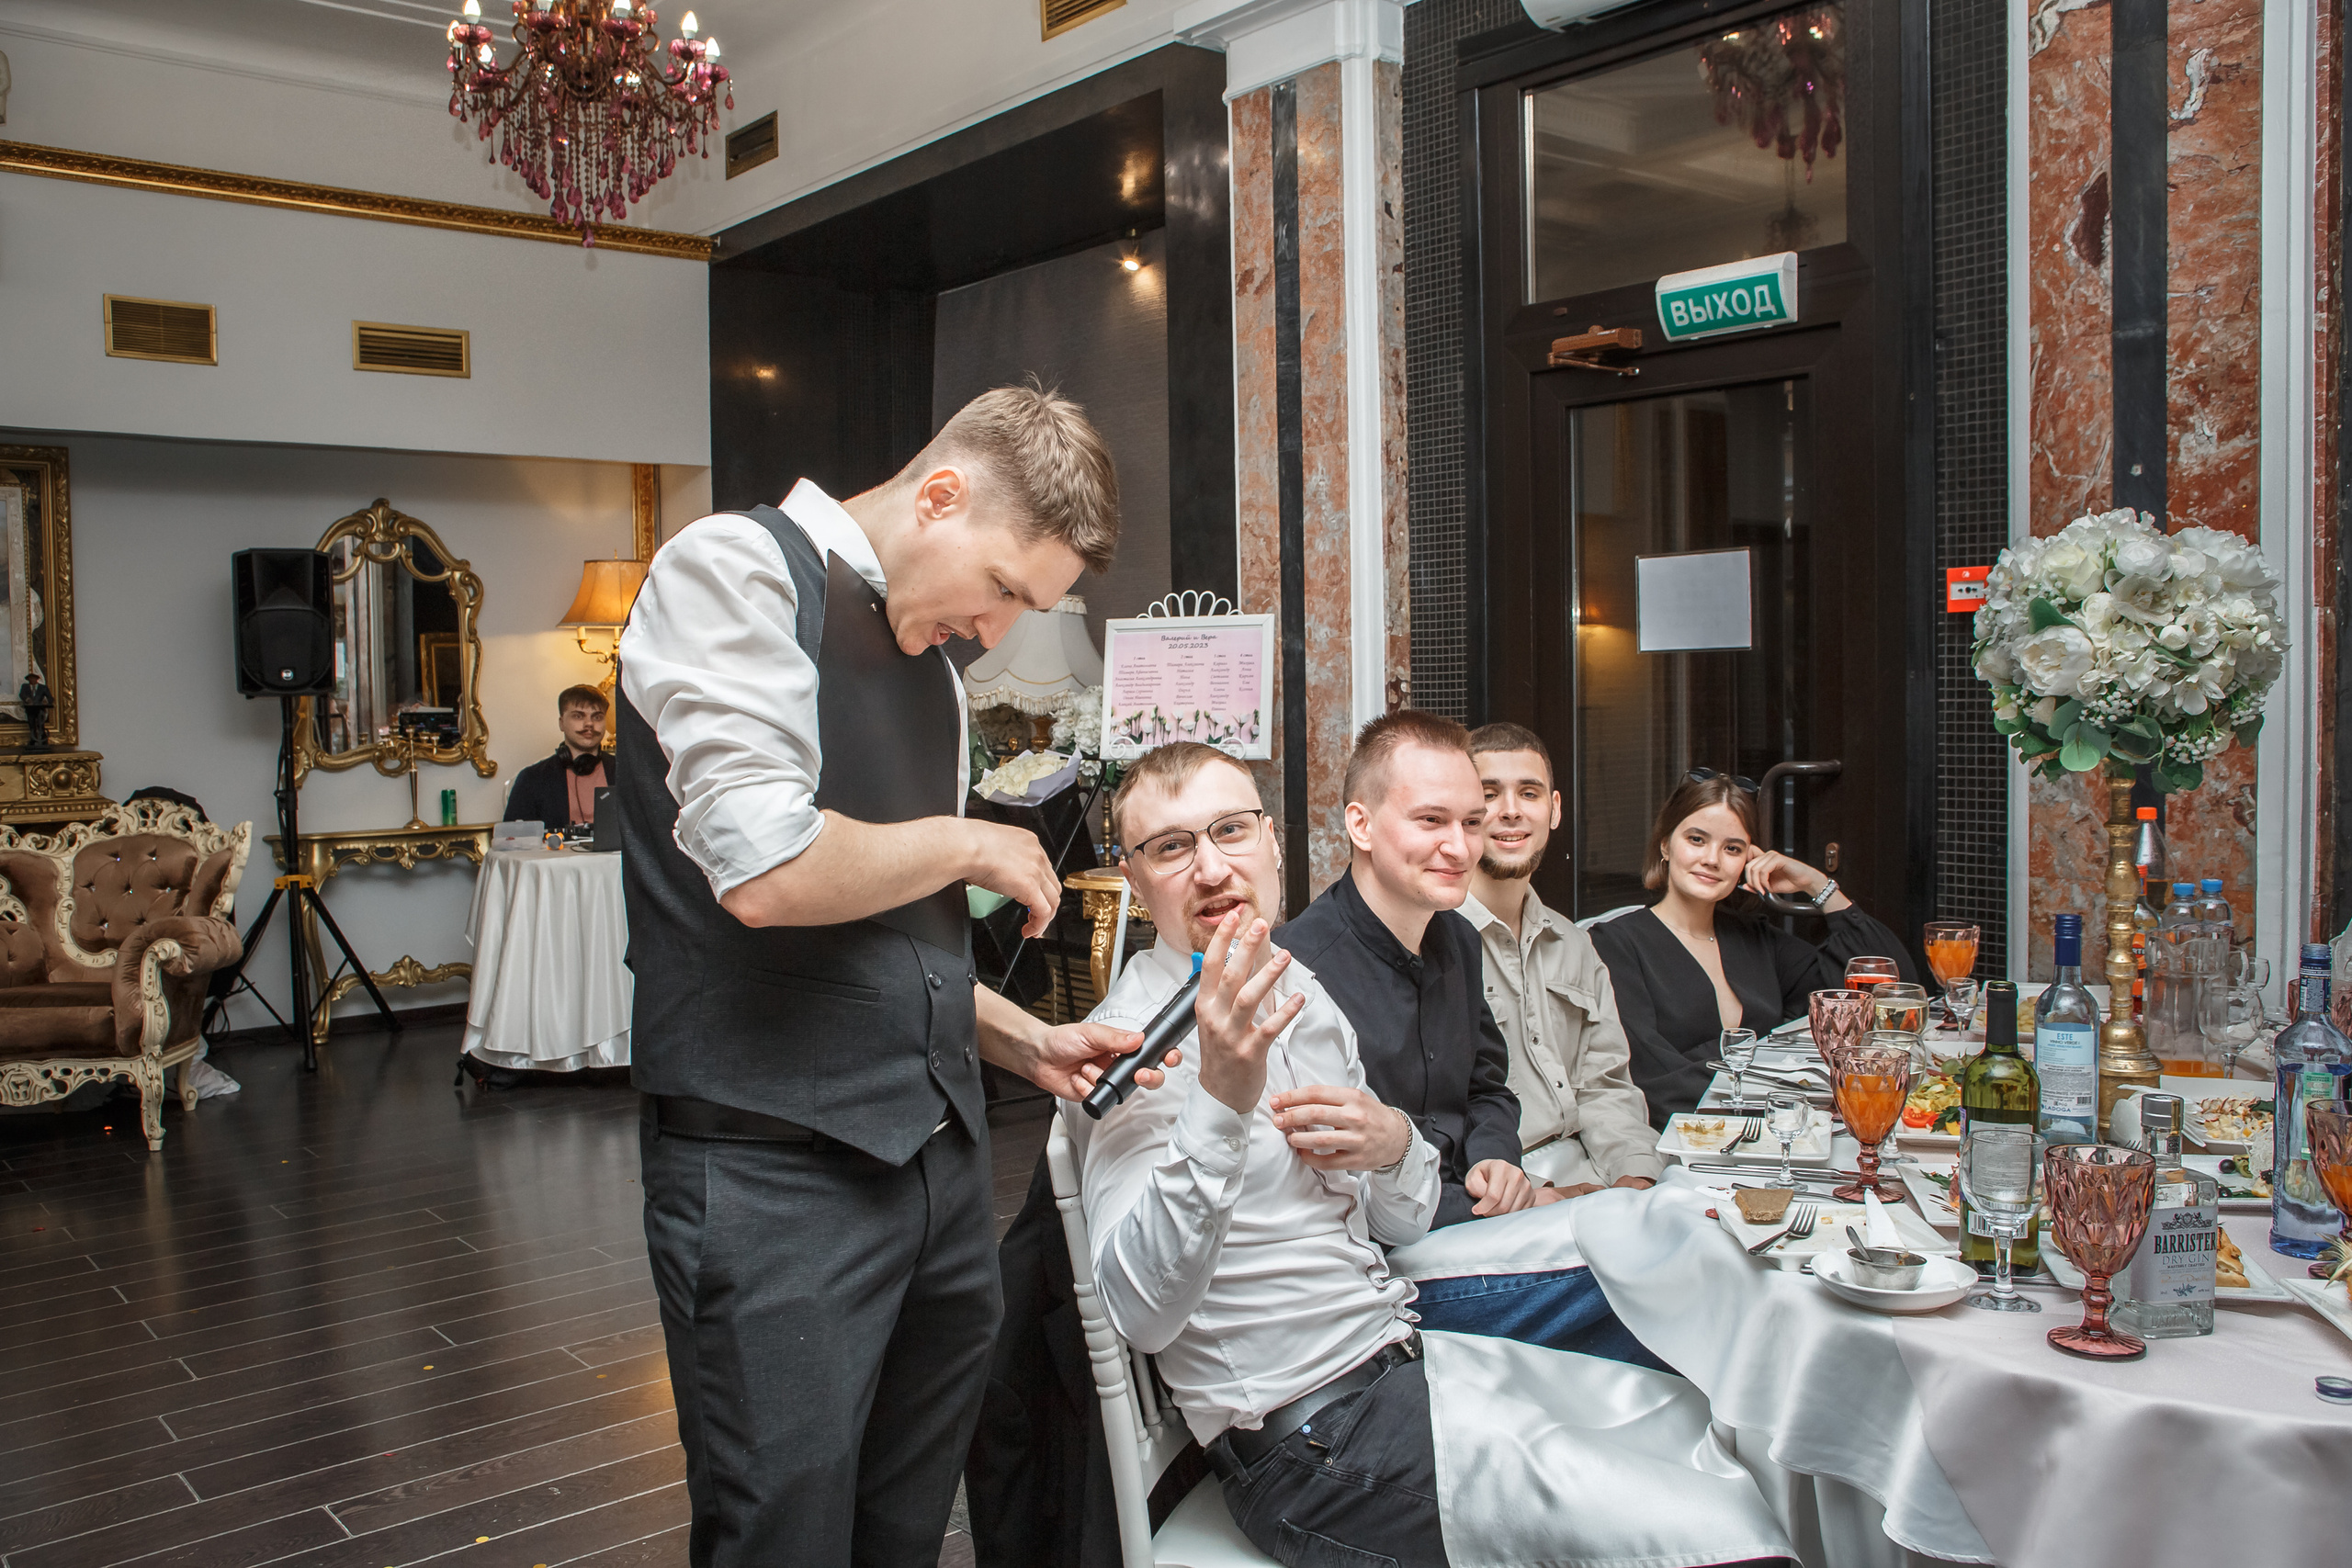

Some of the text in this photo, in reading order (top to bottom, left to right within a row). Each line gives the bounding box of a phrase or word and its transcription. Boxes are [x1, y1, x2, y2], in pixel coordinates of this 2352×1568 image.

[1670, 285, 1777, 327] ВЫХОД
[2154, 1232, 2217, 1254] BARRISTER
[2163, 1253, 2210, 1265] DRY GIN
